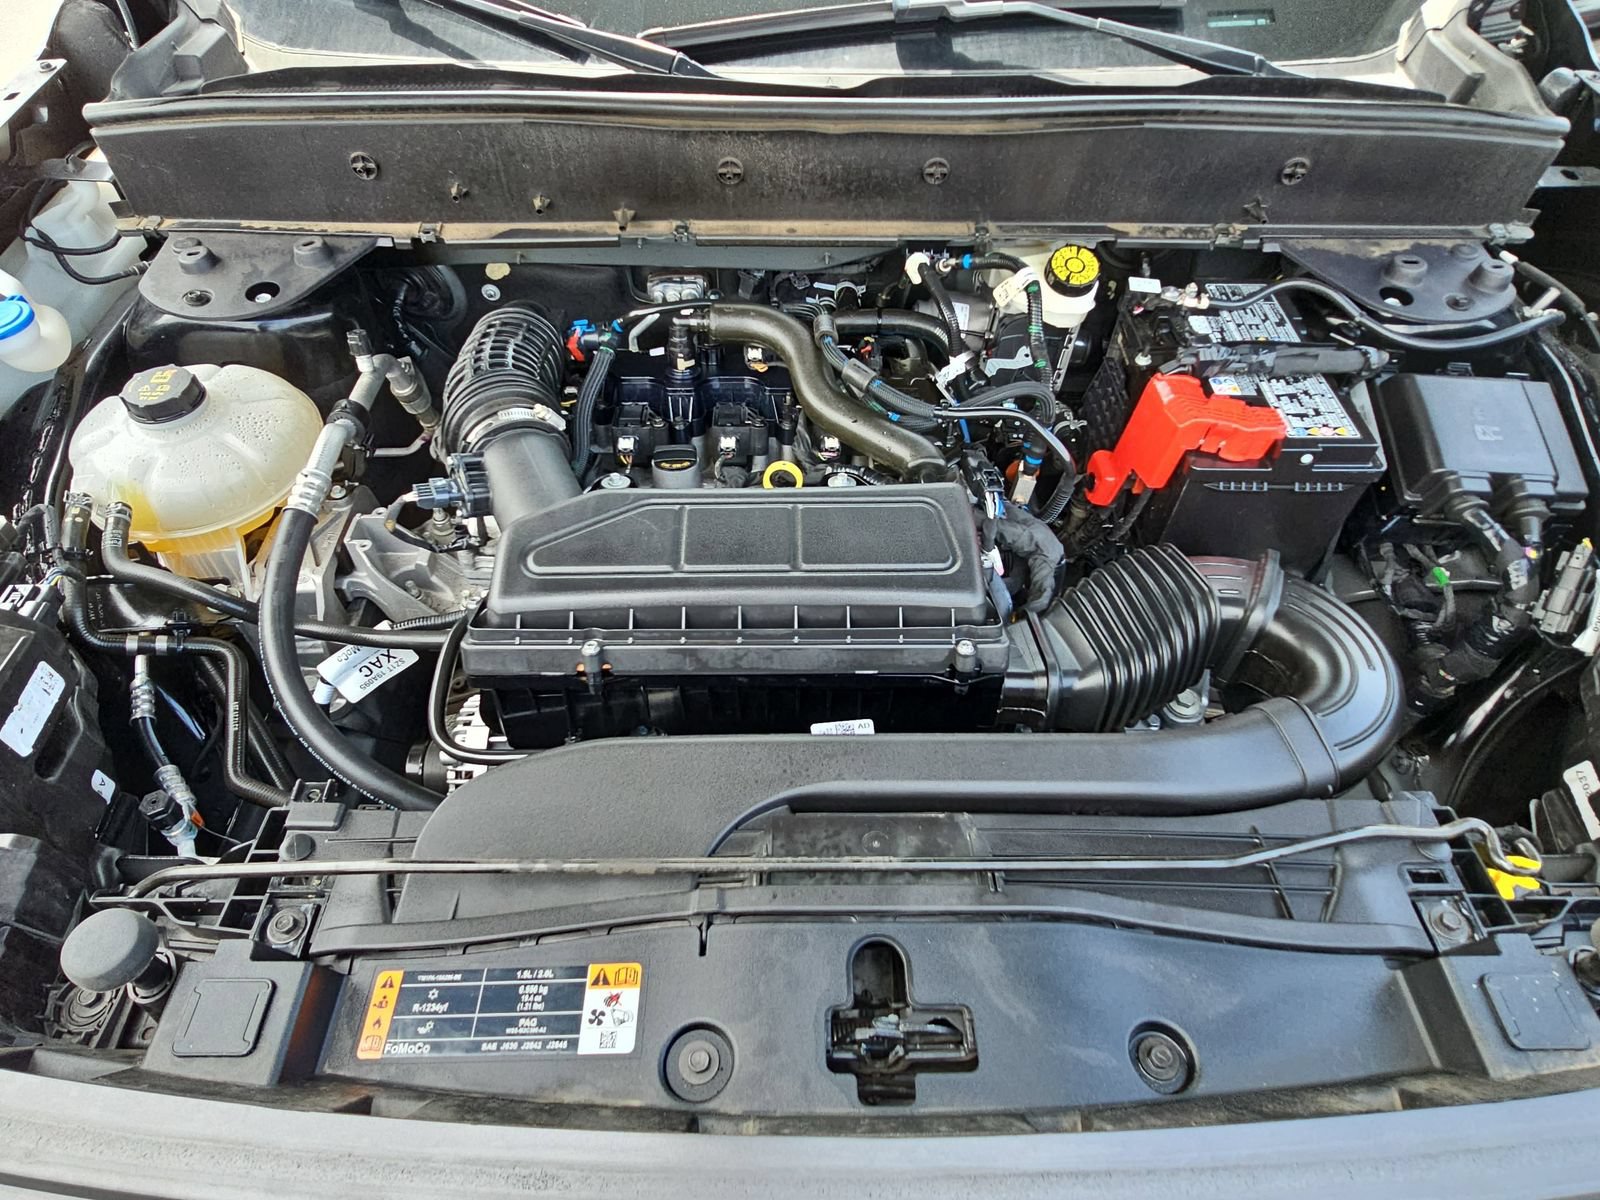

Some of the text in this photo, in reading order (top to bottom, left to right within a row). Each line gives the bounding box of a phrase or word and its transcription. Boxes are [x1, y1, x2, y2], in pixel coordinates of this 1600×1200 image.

[336, 645, 362, 663] MoCo
[359, 648, 397, 678] XAC
[384, 1042, 431, 1054] FoMoCo
